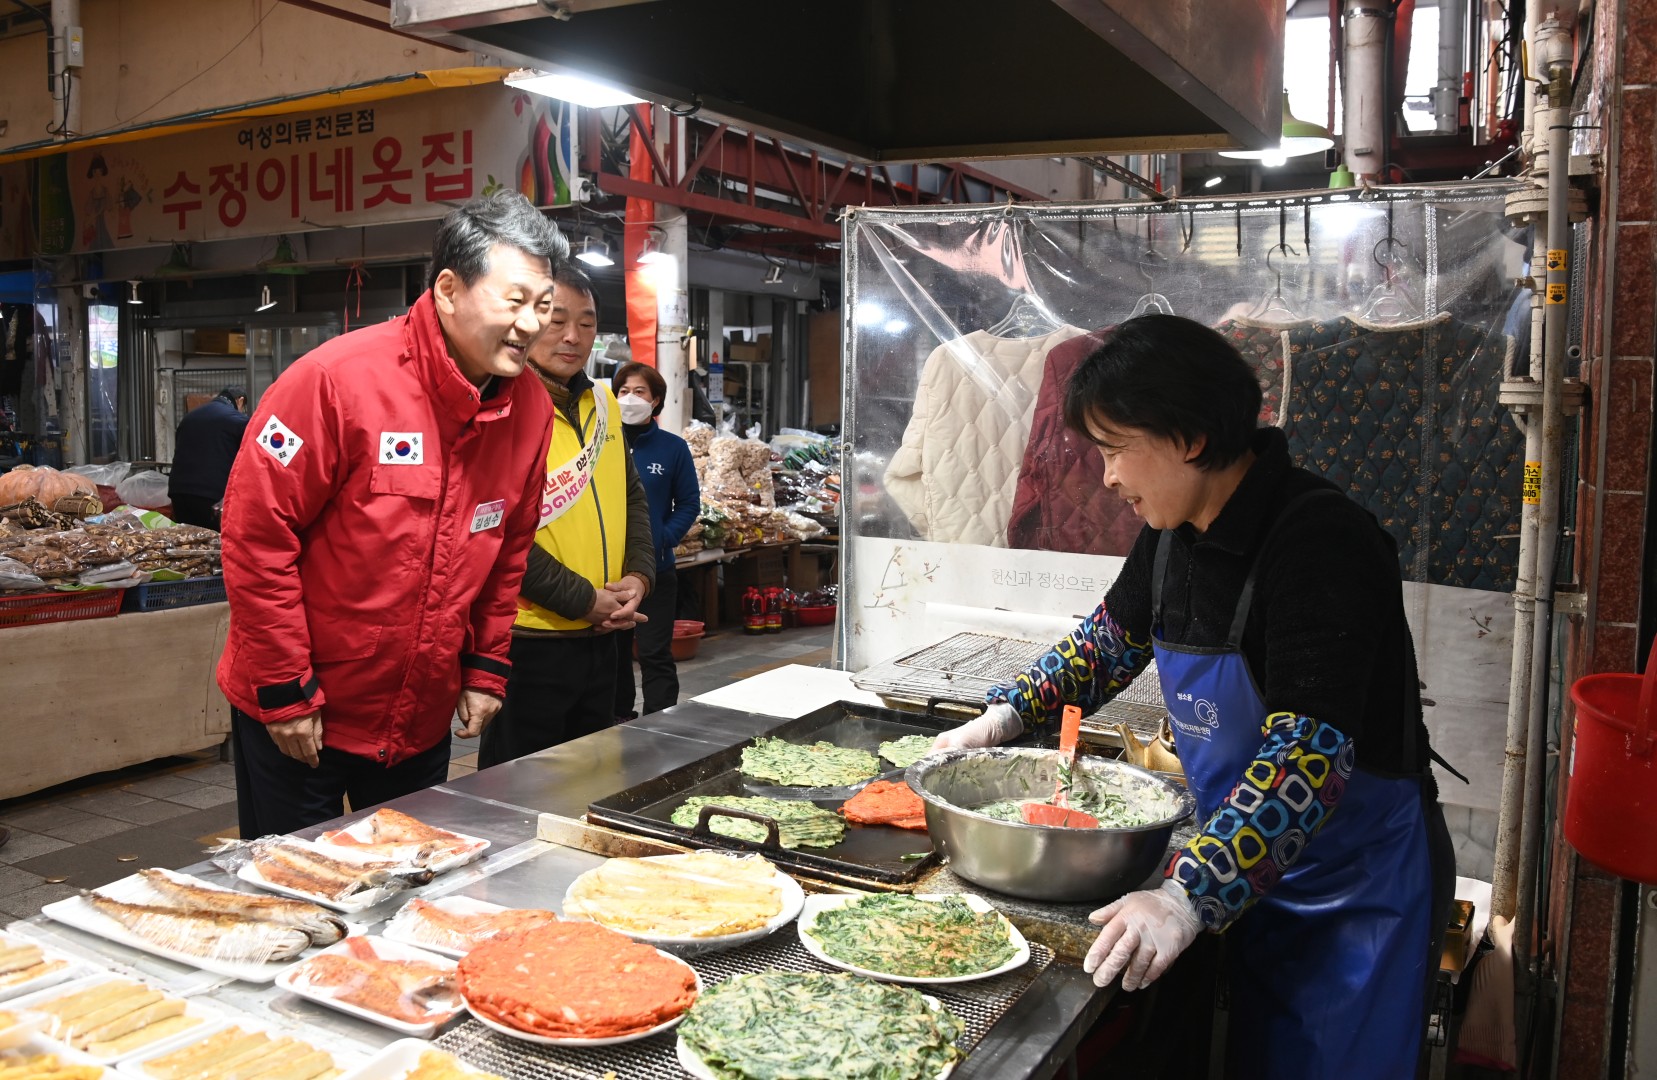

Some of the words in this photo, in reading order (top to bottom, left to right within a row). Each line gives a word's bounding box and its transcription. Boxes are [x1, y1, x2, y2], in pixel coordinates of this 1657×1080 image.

[238, 109, 374, 150] 여성의류전문점
[163, 130, 473, 230] 수정이네옷집
[545, 469, 574, 496] 살리
[1524, 468, 1538, 477] 가스
[476, 513, 499, 530] 김성수
[992, 568, 1033, 588] 헌신과
[1037, 572, 1095, 592] 정성으로
[1176, 692, 1193, 702] 청소용
